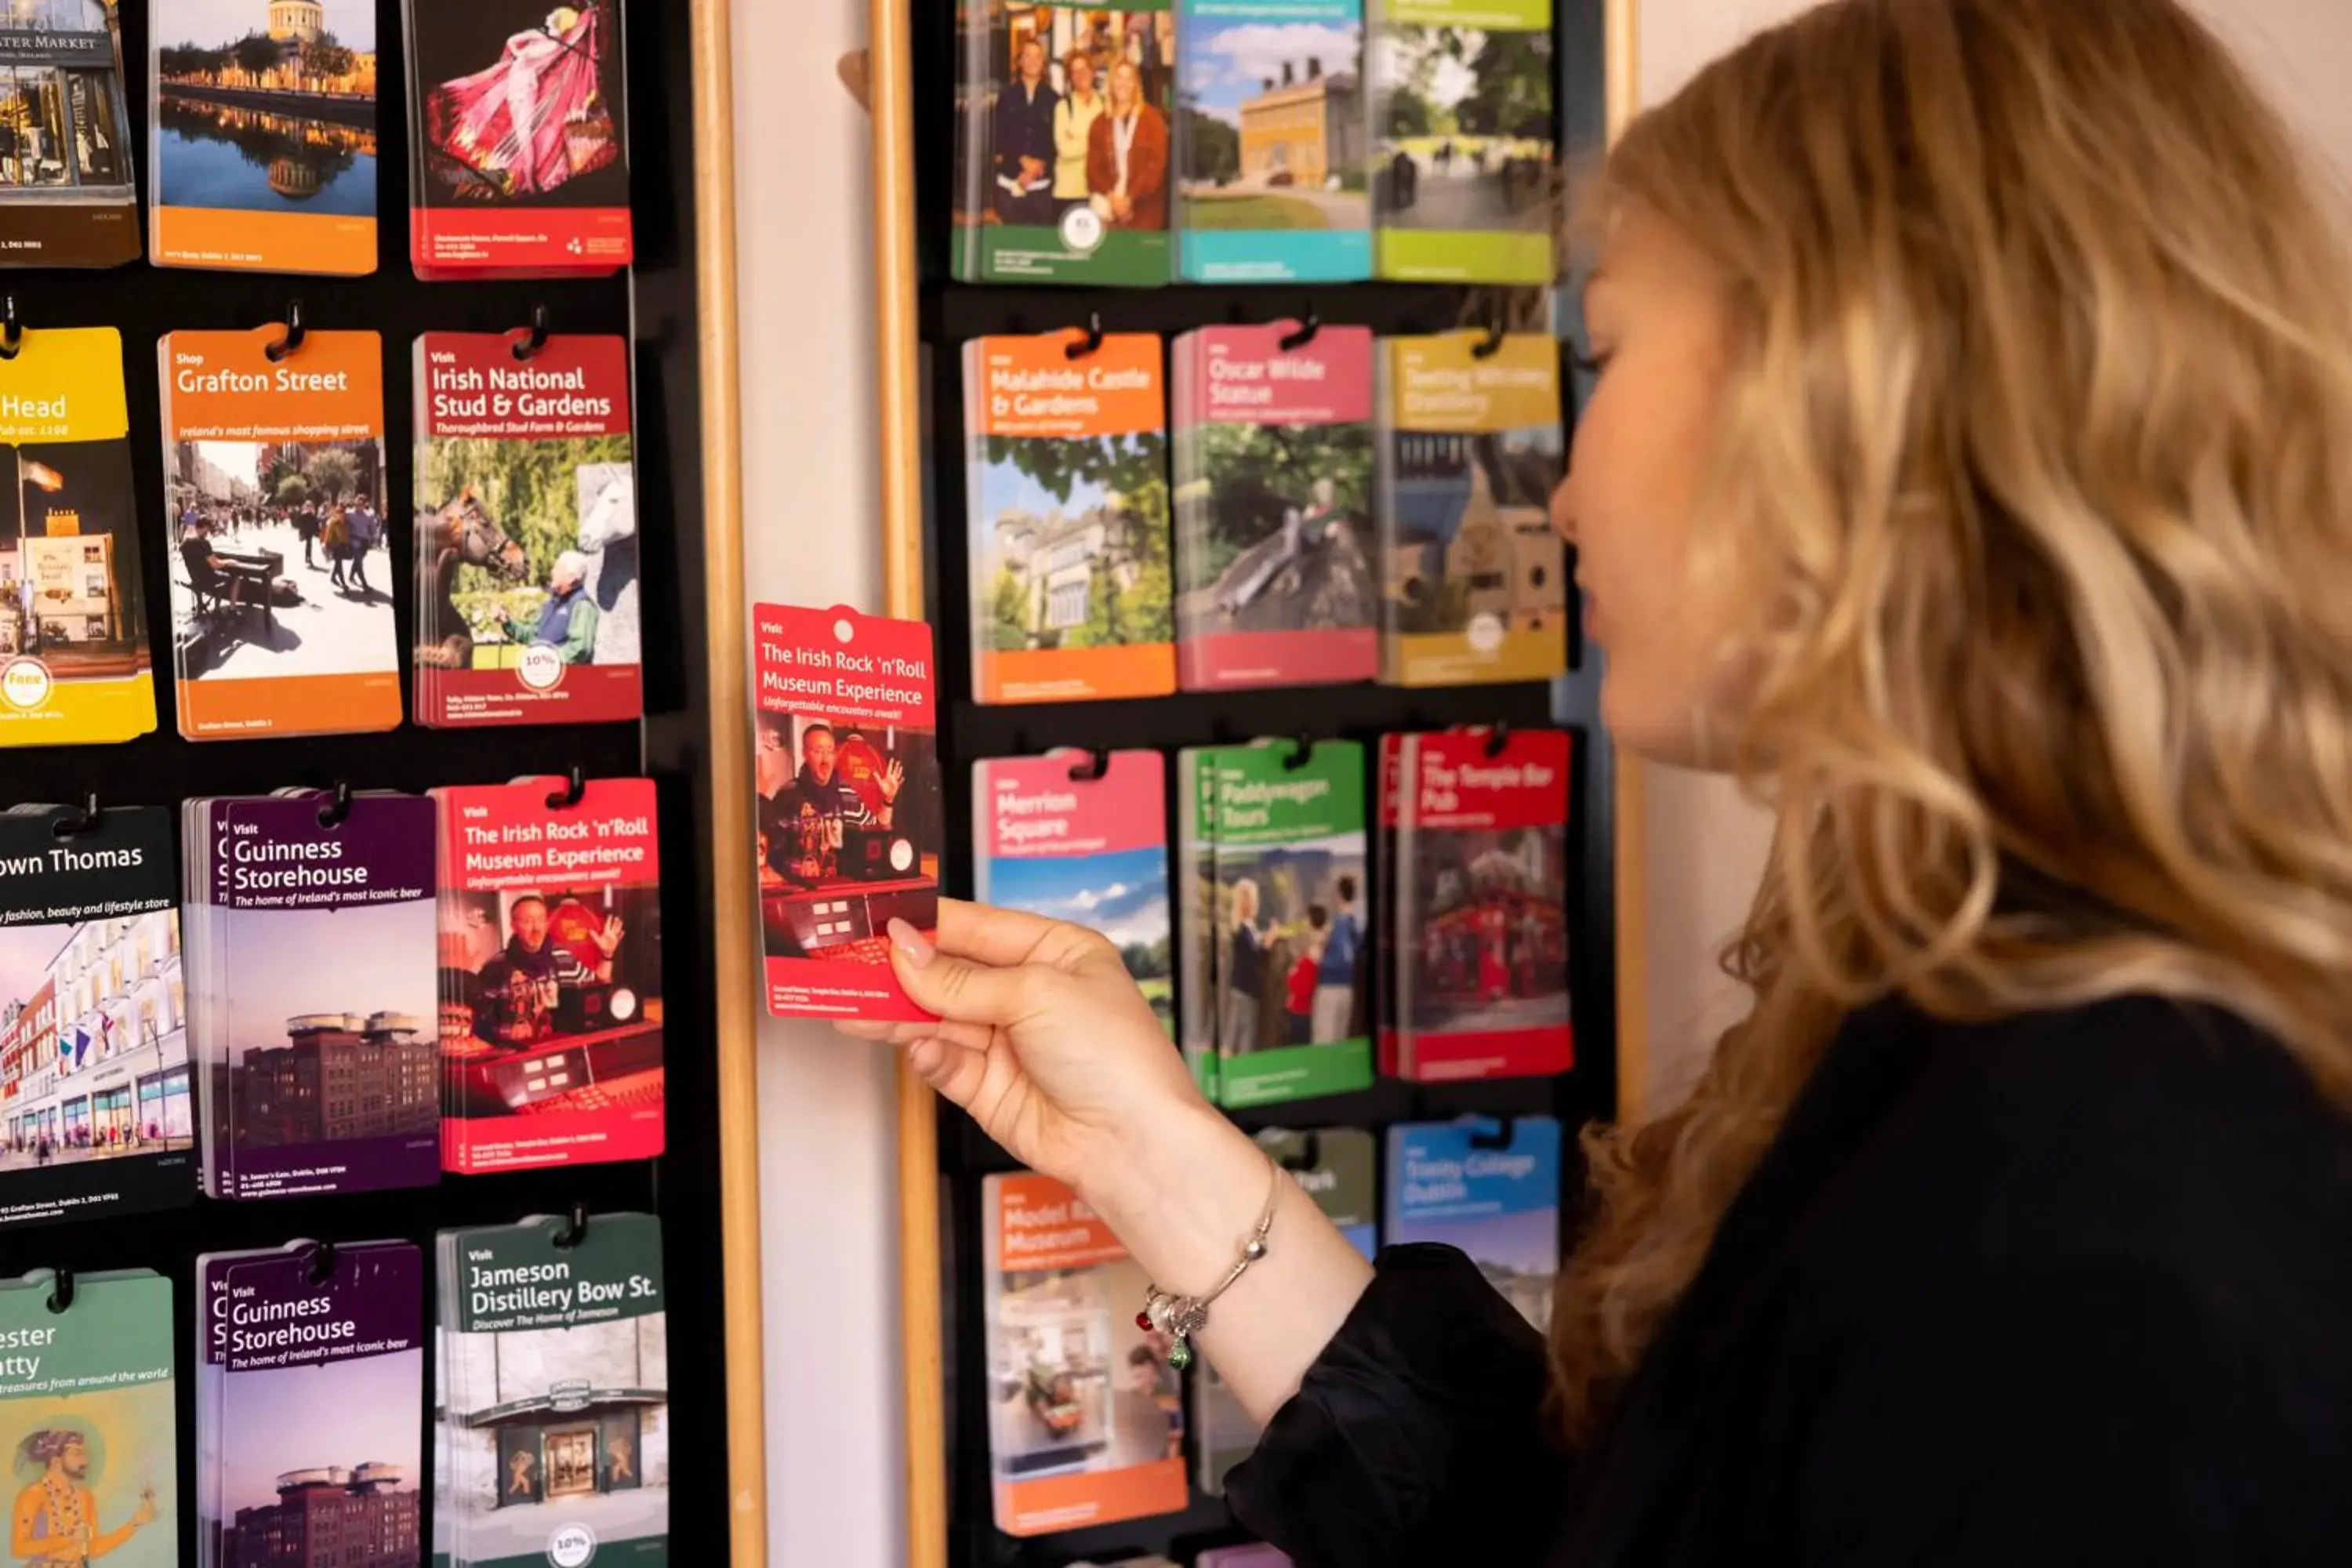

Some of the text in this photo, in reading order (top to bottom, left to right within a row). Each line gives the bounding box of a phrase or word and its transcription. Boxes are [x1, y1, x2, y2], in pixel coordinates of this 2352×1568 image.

[0, 36, 96, 49] TER MARKET
[176, 354, 204, 366] Shop
[430, 352, 456, 363] Visit
[1208, 358, 1325, 379] Oscar Wilde
[177, 368, 347, 393] Grafton Street
[434, 367, 585, 390] Irish National
[990, 366, 1150, 392] Malahide Castle
[1014, 393, 1099, 416] Gardens
[1209, 382, 1273, 405] Statue
[2, 393, 66, 418] Head
[434, 394, 611, 417] Stud & Gardens
[180, 423, 369, 438] Ireland's most famous shopping street
[436, 423, 504, 435] Thoroughbred
[506, 422, 528, 433] Stud
[530, 423, 554, 432] Farm
[566, 422, 605, 432] Gardens
[761, 622, 783, 634] Visit
[762, 643, 793, 662] The
[797, 647, 832, 668] Irish
[836, 652, 873, 673] Rock
[763, 670, 923, 705] Museum Experience
[763, 695, 825, 712] Unforgettable
[826, 704, 874, 717] encounters
[1422, 765, 1457, 786] The
[1458, 764, 1521, 791] Temple
[996, 792, 1077, 815] Merrion
[234, 825, 259, 835] Visit
[465, 826, 499, 844] The
[503, 823, 542, 842] Irish
[546, 821, 589, 840] Rock
[997, 818, 1068, 844] Square
[49, 848, 143, 873] Thomas
[234, 840, 343, 863] Guinness
[466, 846, 644, 871] Museum Experience
[234, 865, 368, 890] Storehouse
[235, 887, 423, 907] The home of Ireland's most iconic beer
[5, 898, 169, 924] fashion, beauty and lifestyle store
[469, 1250, 493, 1261] Visit
[211, 1280, 228, 1292] Vis
[470, 1262, 570, 1288] Jameson
[233, 1287, 256, 1298] Visit
[473, 1275, 657, 1314] Distillery Bow St.
[233, 1297, 331, 1325] Guinness
[473, 1307, 619, 1331] Discover The Home of Jameson
[232, 1320, 355, 1352] Storehouse
[232, 1338, 409, 1370] The home of Ireland's most iconic beer
[0, 1368, 169, 1394] treasures from around the world
